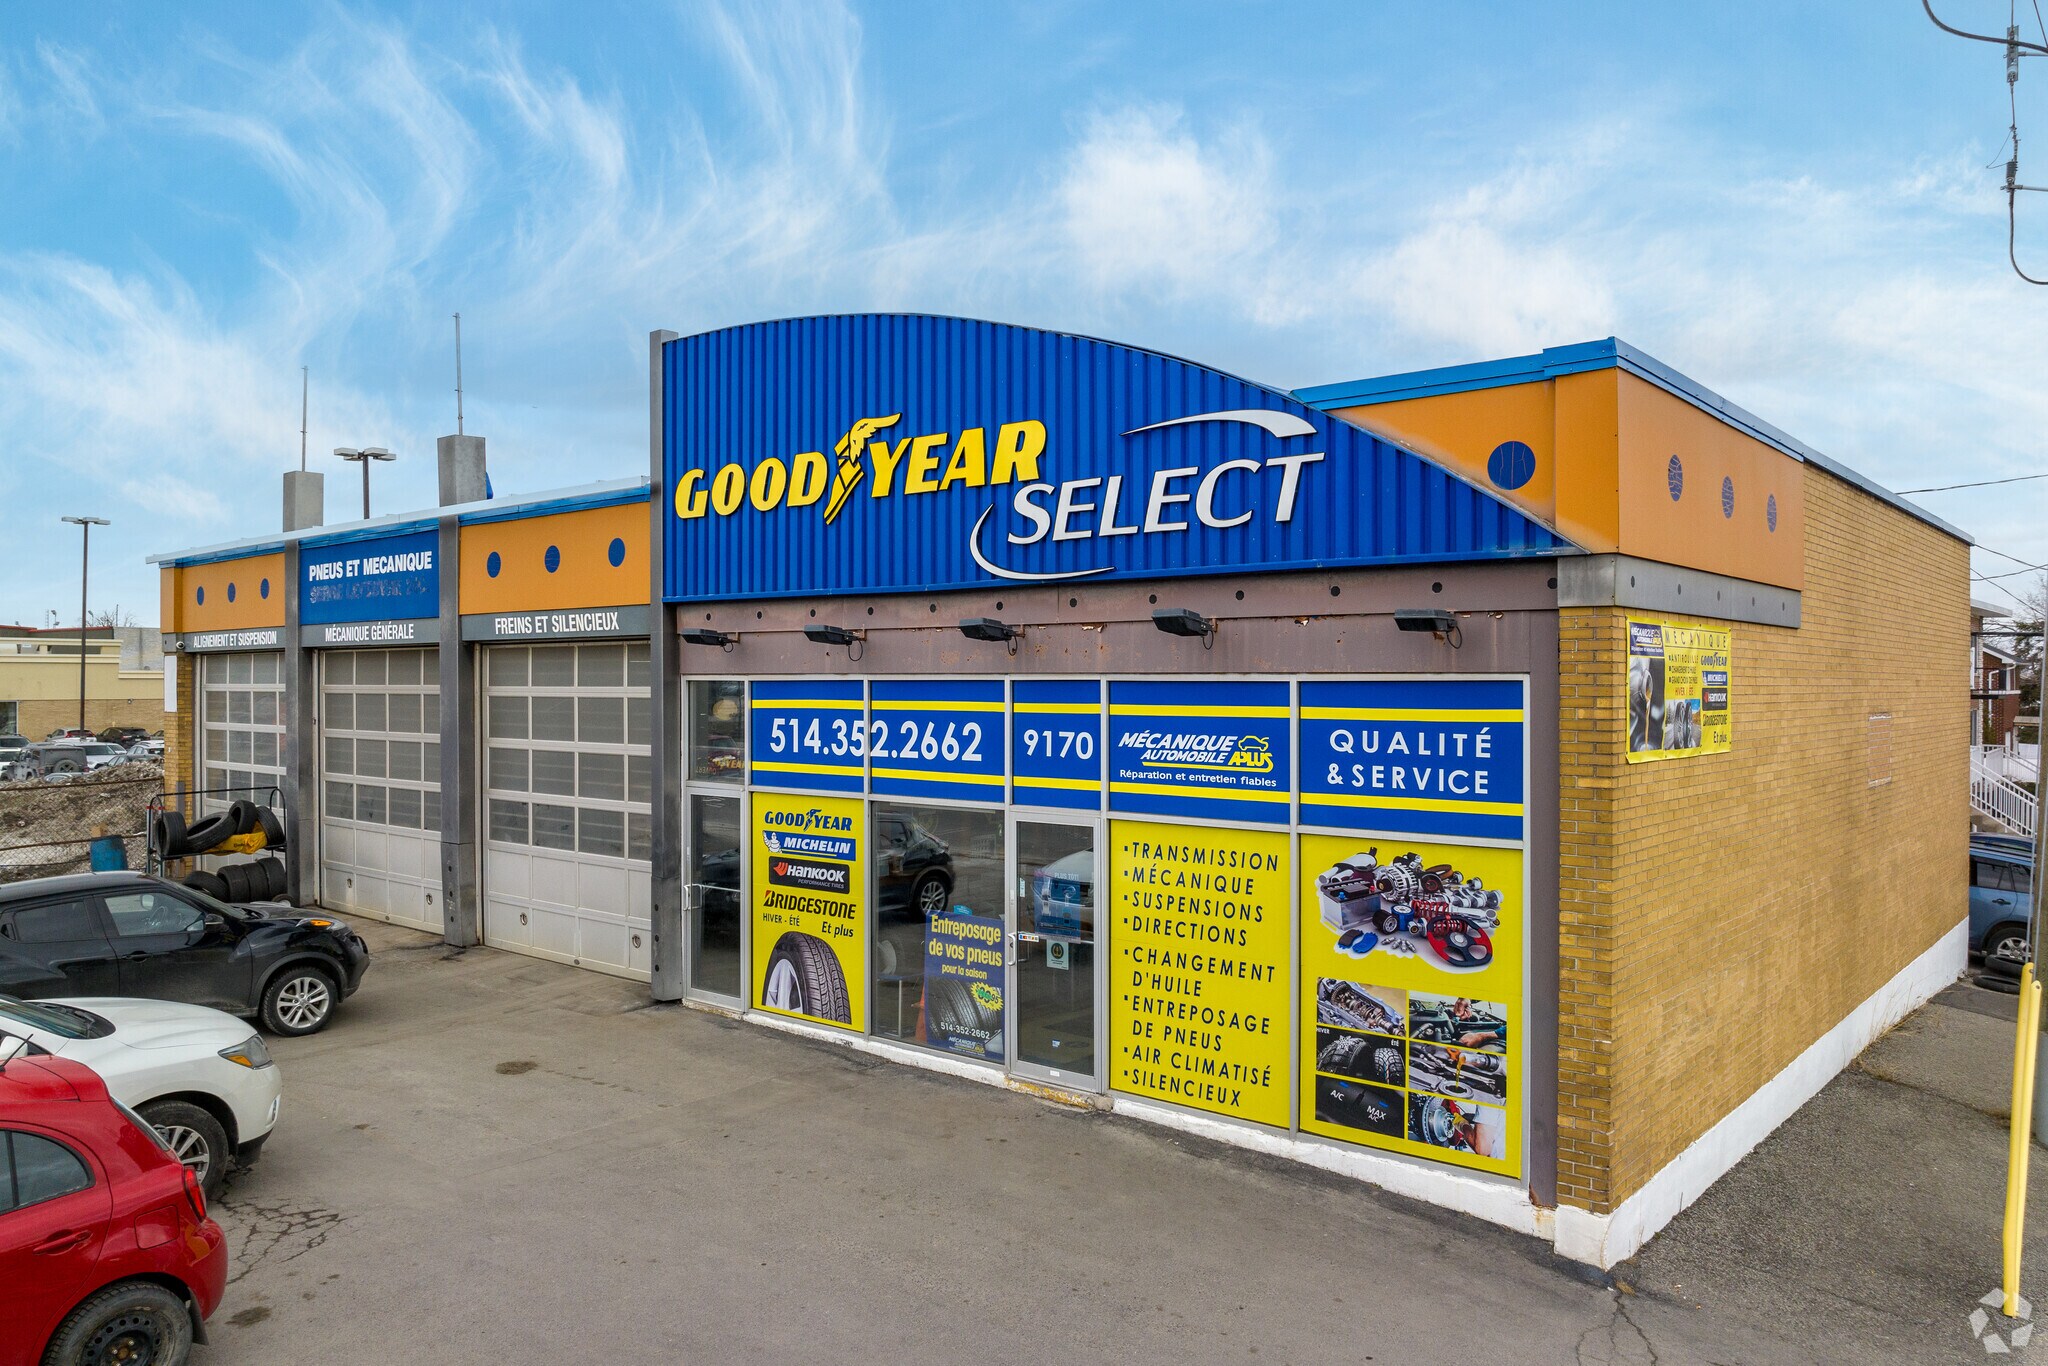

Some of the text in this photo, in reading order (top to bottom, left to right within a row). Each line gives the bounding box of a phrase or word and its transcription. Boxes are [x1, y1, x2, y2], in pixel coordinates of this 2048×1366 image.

[1007, 452, 1325, 546] SELECT
[309, 551, 433, 582] PNEUS ET MECANIQUE
[325, 622, 415, 642] MÉCANIQUE GÉNÉRALE
[494, 611, 620, 635] FREINS ET SILENCIEUX
[193, 630, 277, 649] ALIGNEMENT ET SUSPENSION
[769, 717, 983, 762] 514.352.2662
[1023, 729, 1094, 760] 9170
[1118, 730, 1238, 751] MÉCANIQUE
[1330, 727, 1492, 758] QUALITÉ
[1140, 749, 1229, 763] AUTOMOBILE
[1120, 769, 1172, 780] Réparation
[1188, 774, 1236, 784] entretien
[1241, 776, 1277, 787] fiables
[1327, 762, 1489, 794] & SERVICE
[783, 837, 851, 854] MICHELIN
[1132, 842, 1279, 872] TRANSMISSION
[798, 879, 831, 888] PERFORMANCE
[1132, 864, 1254, 895] MÉCANIQUE
[763, 890, 857, 919] BRIDGESTONE
[1132, 891, 1263, 923] SUSPENSIONS
[763, 913, 782, 924] HIVER
[789, 915, 800, 926] ÉTÉ
[821, 921, 854, 938] Et plus
[931, 915, 1001, 946] Entreposage
[1132, 916, 1247, 946] DIRECTIONS
[929, 938, 1002, 967] de vos pneus
[1132, 946, 1275, 983] CHANGEMENT
[942, 963, 987, 980] pour la saison
[1132, 971, 1202, 997] D'HUILE
[1132, 995, 1270, 1035] ENTREPOSAGE
[940, 1022, 990, 1039] 514-352-2662
[1132, 1020, 1222, 1052] DE PNEUS
[1132, 1045, 1271, 1088] AIR CLIMATISÉ
[1132, 1069, 1241, 1107] SILENCIEUX
[1330, 1089, 1345, 1102] A/C
[1366, 1105, 1386, 1121] MAX
